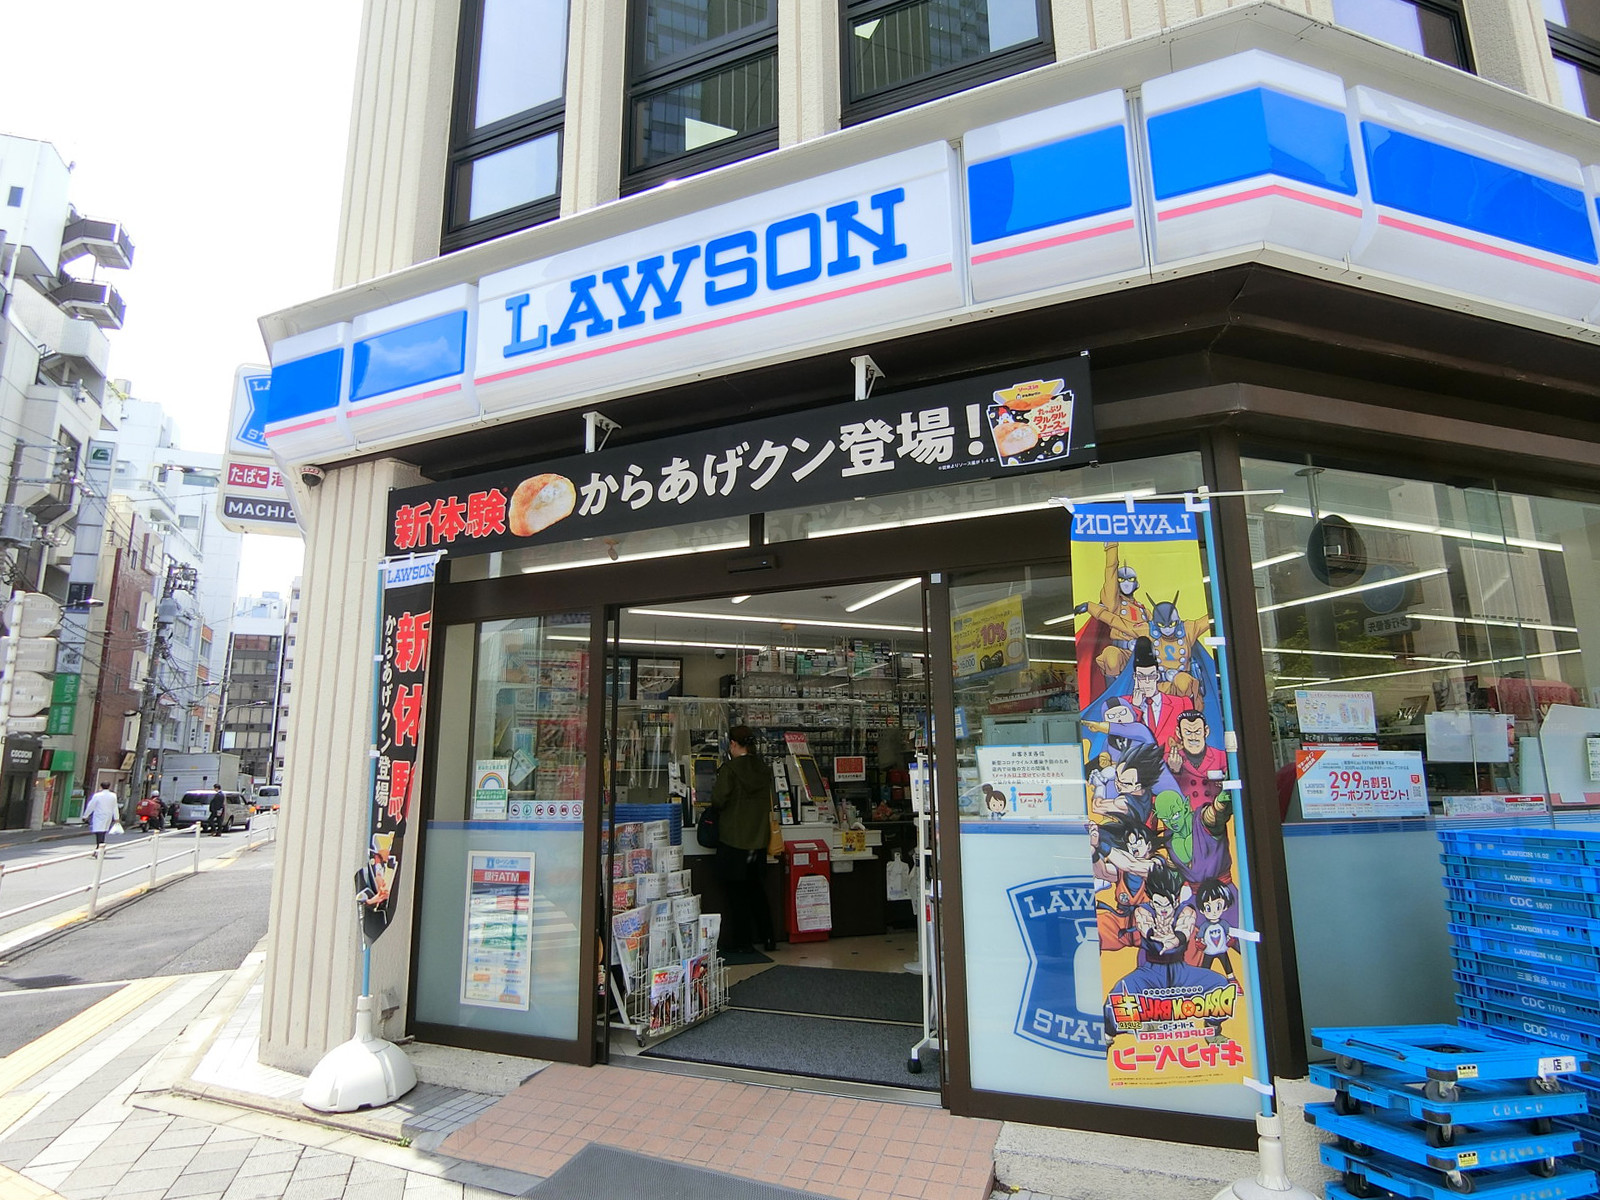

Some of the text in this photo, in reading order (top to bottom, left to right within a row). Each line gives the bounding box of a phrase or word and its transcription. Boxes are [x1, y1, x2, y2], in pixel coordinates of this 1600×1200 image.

[503, 187, 907, 358] LAWSON
[1033, 412, 1067, 426] タルタル
[230, 466, 268, 485] たばこ
[228, 501, 285, 519] MACHI
[394, 488, 507, 549] 新体験
[387, 562, 435, 584] LAWSON
[1329, 770, 1392, 789] 299円割引
[1331, 789, 1410, 801] クーポンプレゼント!
[1510, 896, 1534, 908] CDC
[1521, 996, 1546, 1010] CDC
[1523, 1022, 1548, 1037] CDC
